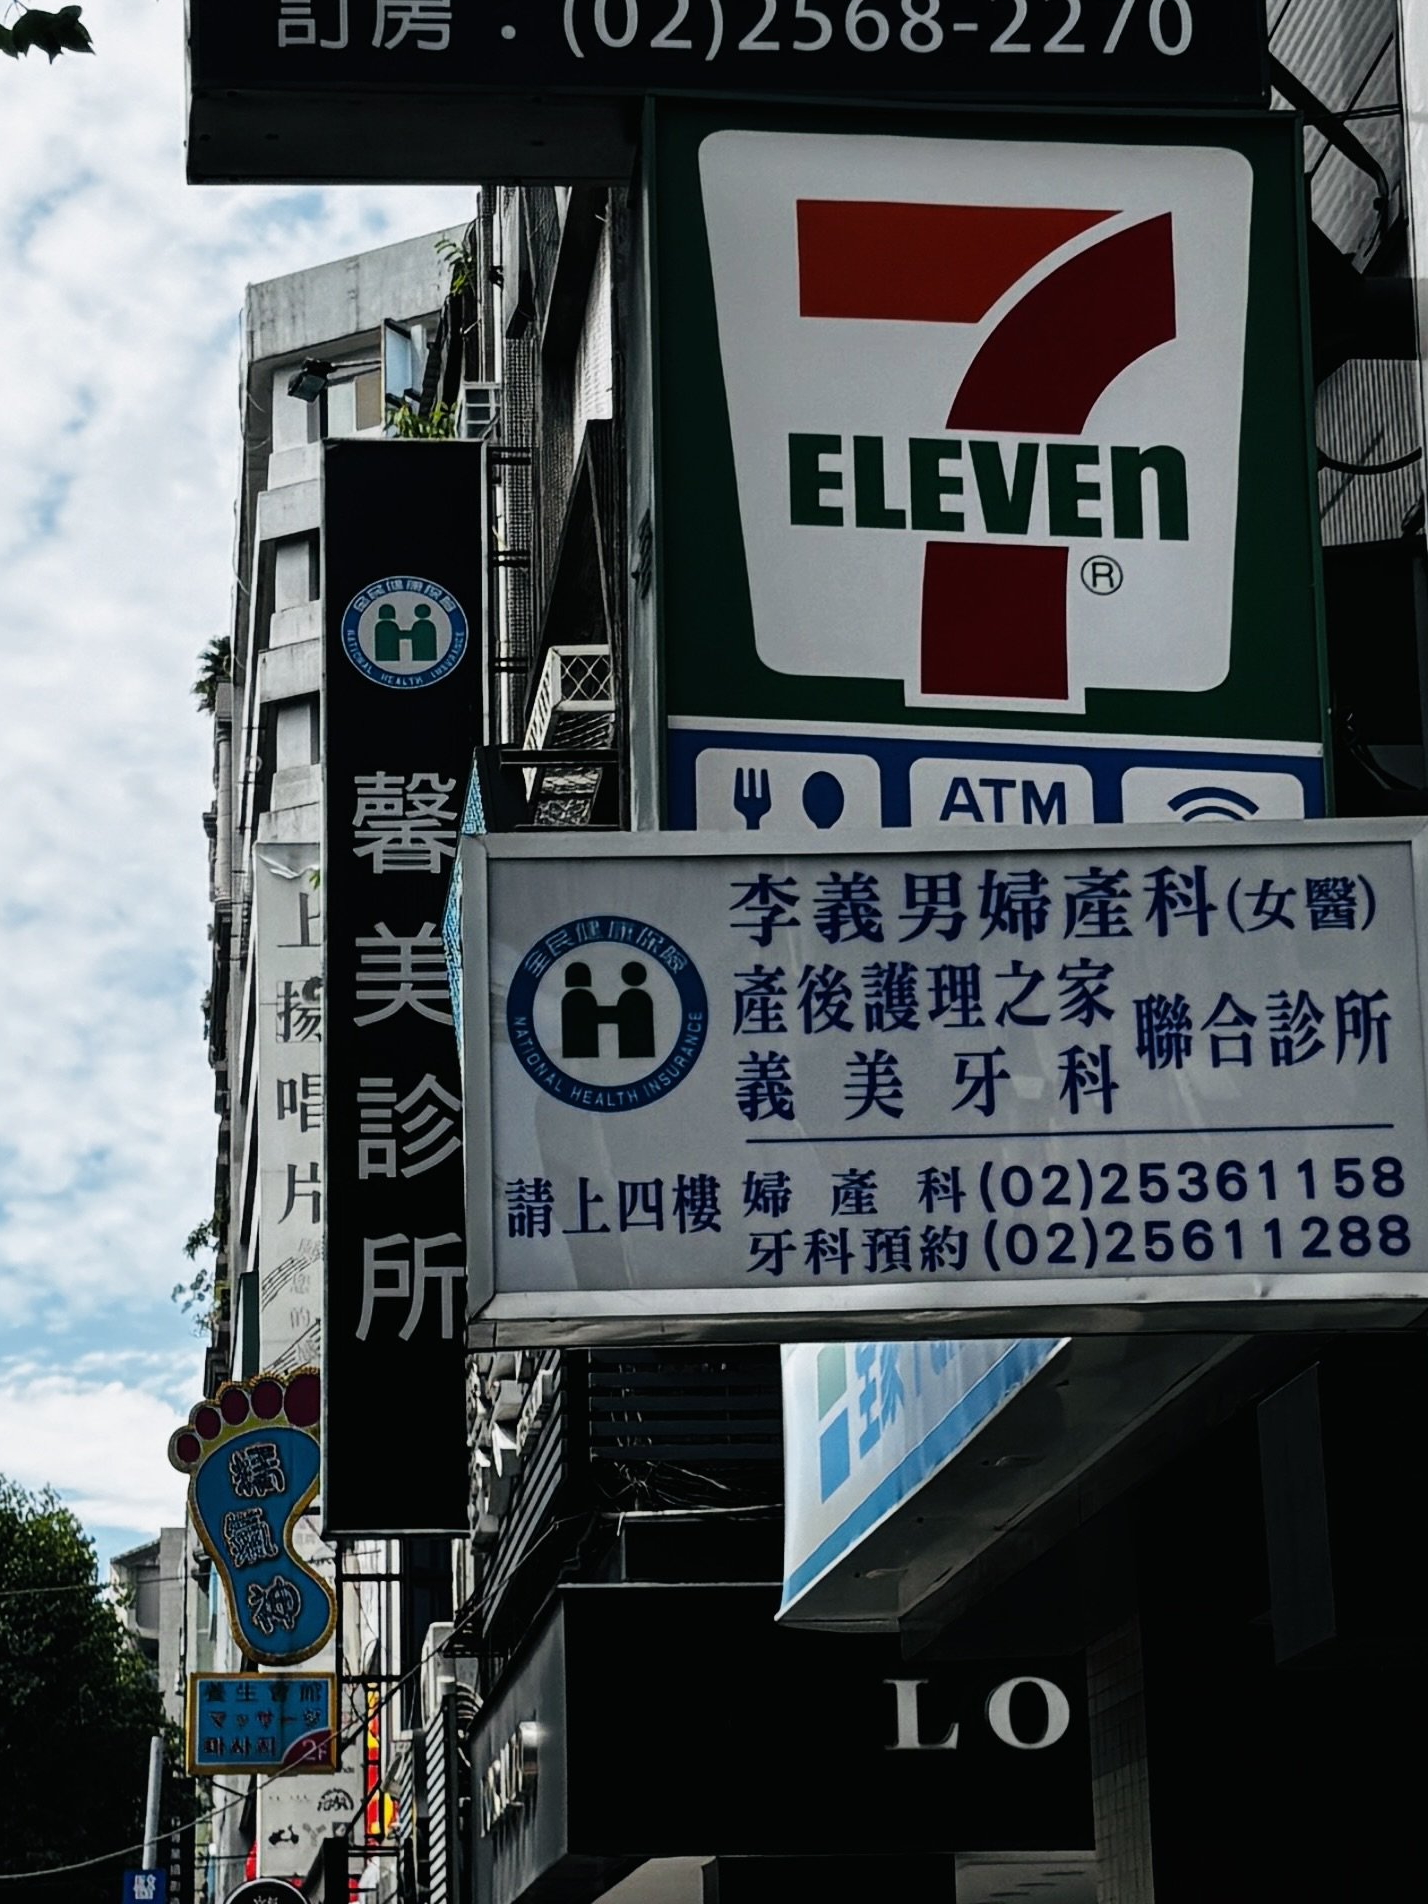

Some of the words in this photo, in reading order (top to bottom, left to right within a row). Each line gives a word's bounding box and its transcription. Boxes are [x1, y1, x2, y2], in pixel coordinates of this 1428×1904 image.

[940, 777, 1067, 825] ATM
[732, 958, 1115, 1039] 產後護理之家
[1135, 987, 1391, 1072] 聯合診所
[352, 771, 466, 1342] 馨美診所
[513, 1016, 563, 1093] NATIONAL
[642, 1011, 703, 1098] INSURANCE
[734, 1044, 1120, 1123] 義美牙科
[570, 1086, 639, 1107] HEALTH
[505, 1175, 722, 1239] 請上四樓
